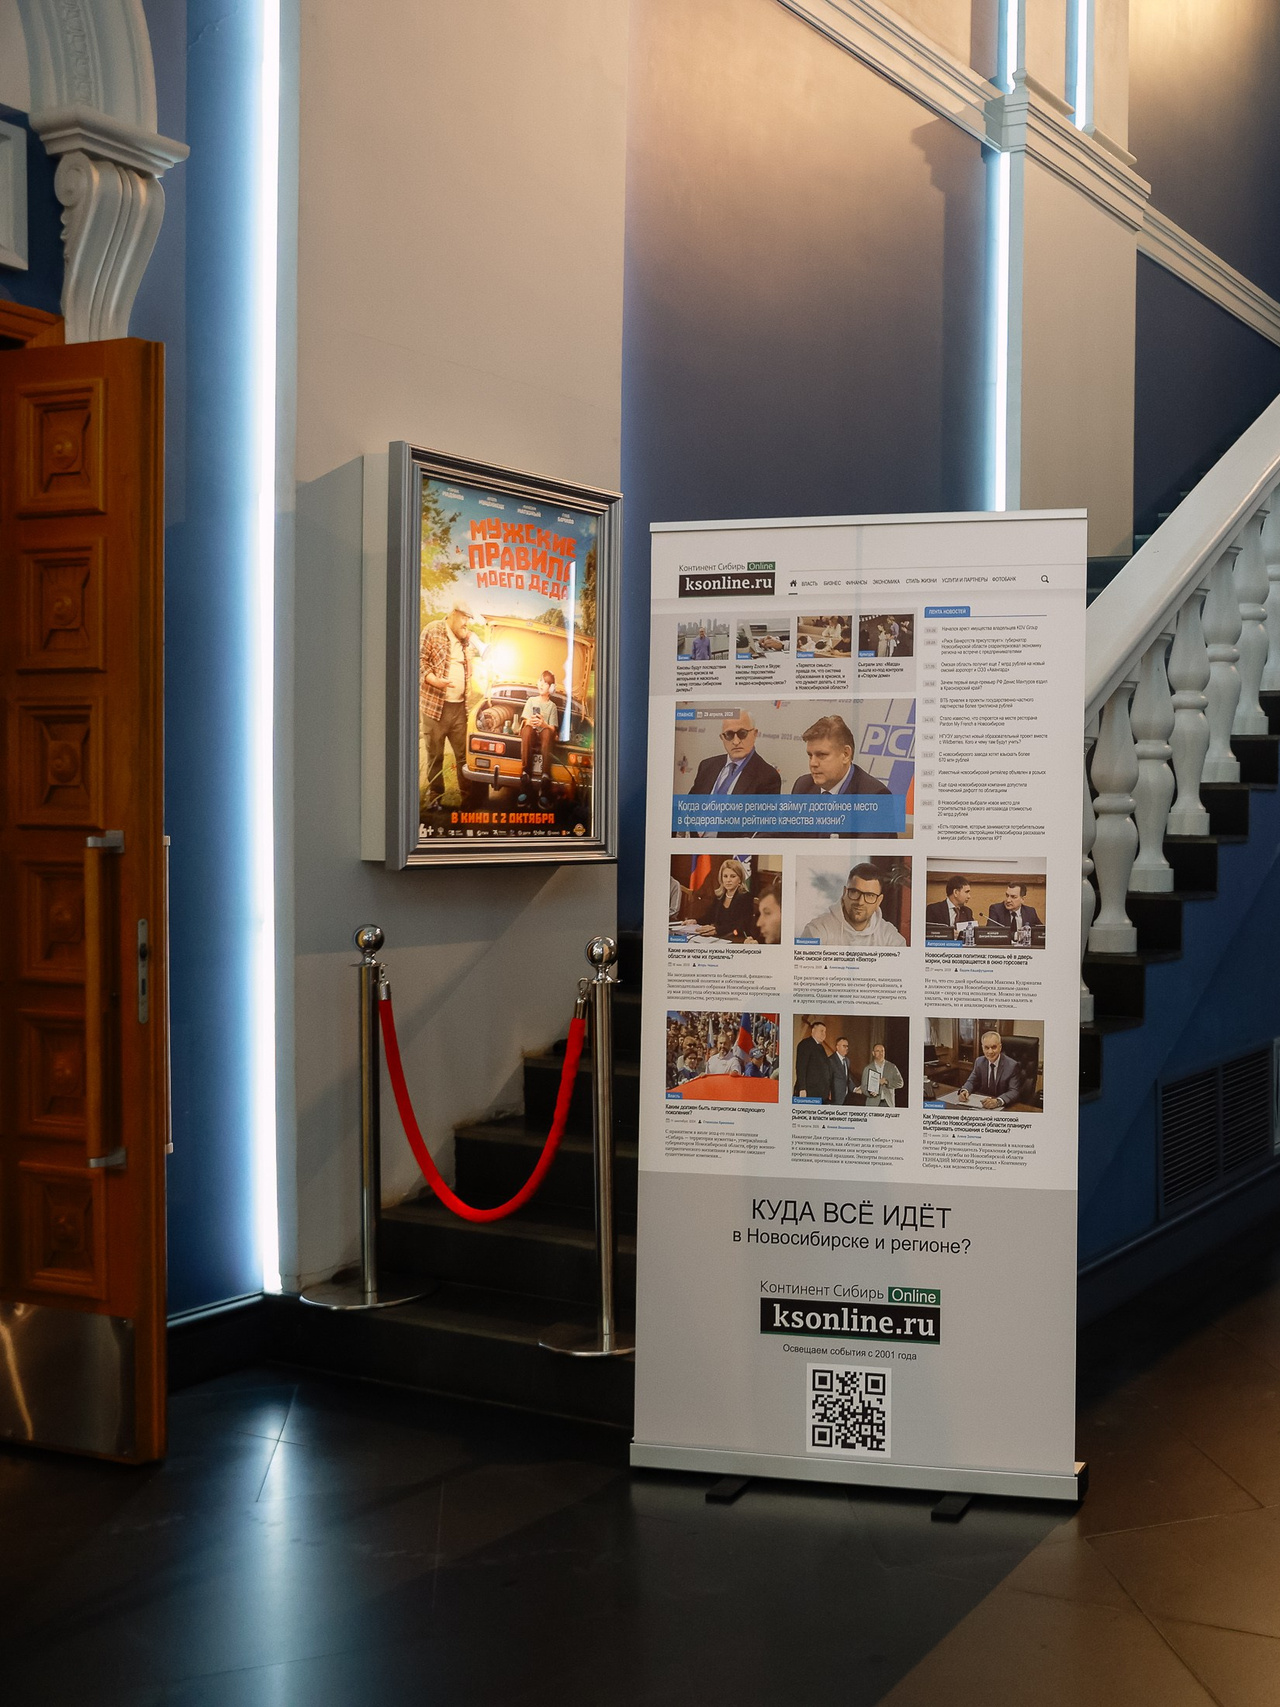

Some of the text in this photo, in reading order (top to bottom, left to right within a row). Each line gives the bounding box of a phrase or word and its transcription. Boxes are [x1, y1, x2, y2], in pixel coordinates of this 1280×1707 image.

[470, 518, 577, 558] МУЖСКИЕ
[468, 542, 572, 582] ПРАВИЛА
[679, 563, 716, 572] Континент
[718, 563, 745, 571] Сибирь
[476, 570, 569, 600] МОЕГО ДЕДА
[686, 576, 772, 590] ksonline.ru
[860, 726, 915, 757] РС
[451, 812, 555, 824] В КИНО С 2 ОКТЯБРЯ
[678, 802, 699, 812] Когда
[701, 802, 742, 813] сибирские
[744, 804, 777, 813] регионы
[779, 802, 807, 813] займут
[809, 802, 851, 813] достойное
[419, 824, 434, 837] 6+
[684, 816, 739, 827] федеральном
[741, 816, 776, 827] рейтинге
[815, 816, 845, 824] жизни?
[752, 1199, 951, 1231] КУДА ВСЁ ИДЁТ
[733, 1228, 971, 1255] в Новосибирске и регионе?
[760, 1281, 936, 1303] Континент Сибирь Online
[773, 1304, 935, 1336] ksonline.ru
[783, 1344, 828, 1355] Освещаем
[830, 1348, 866, 1357] события
[875, 1350, 895, 1358] 2001
